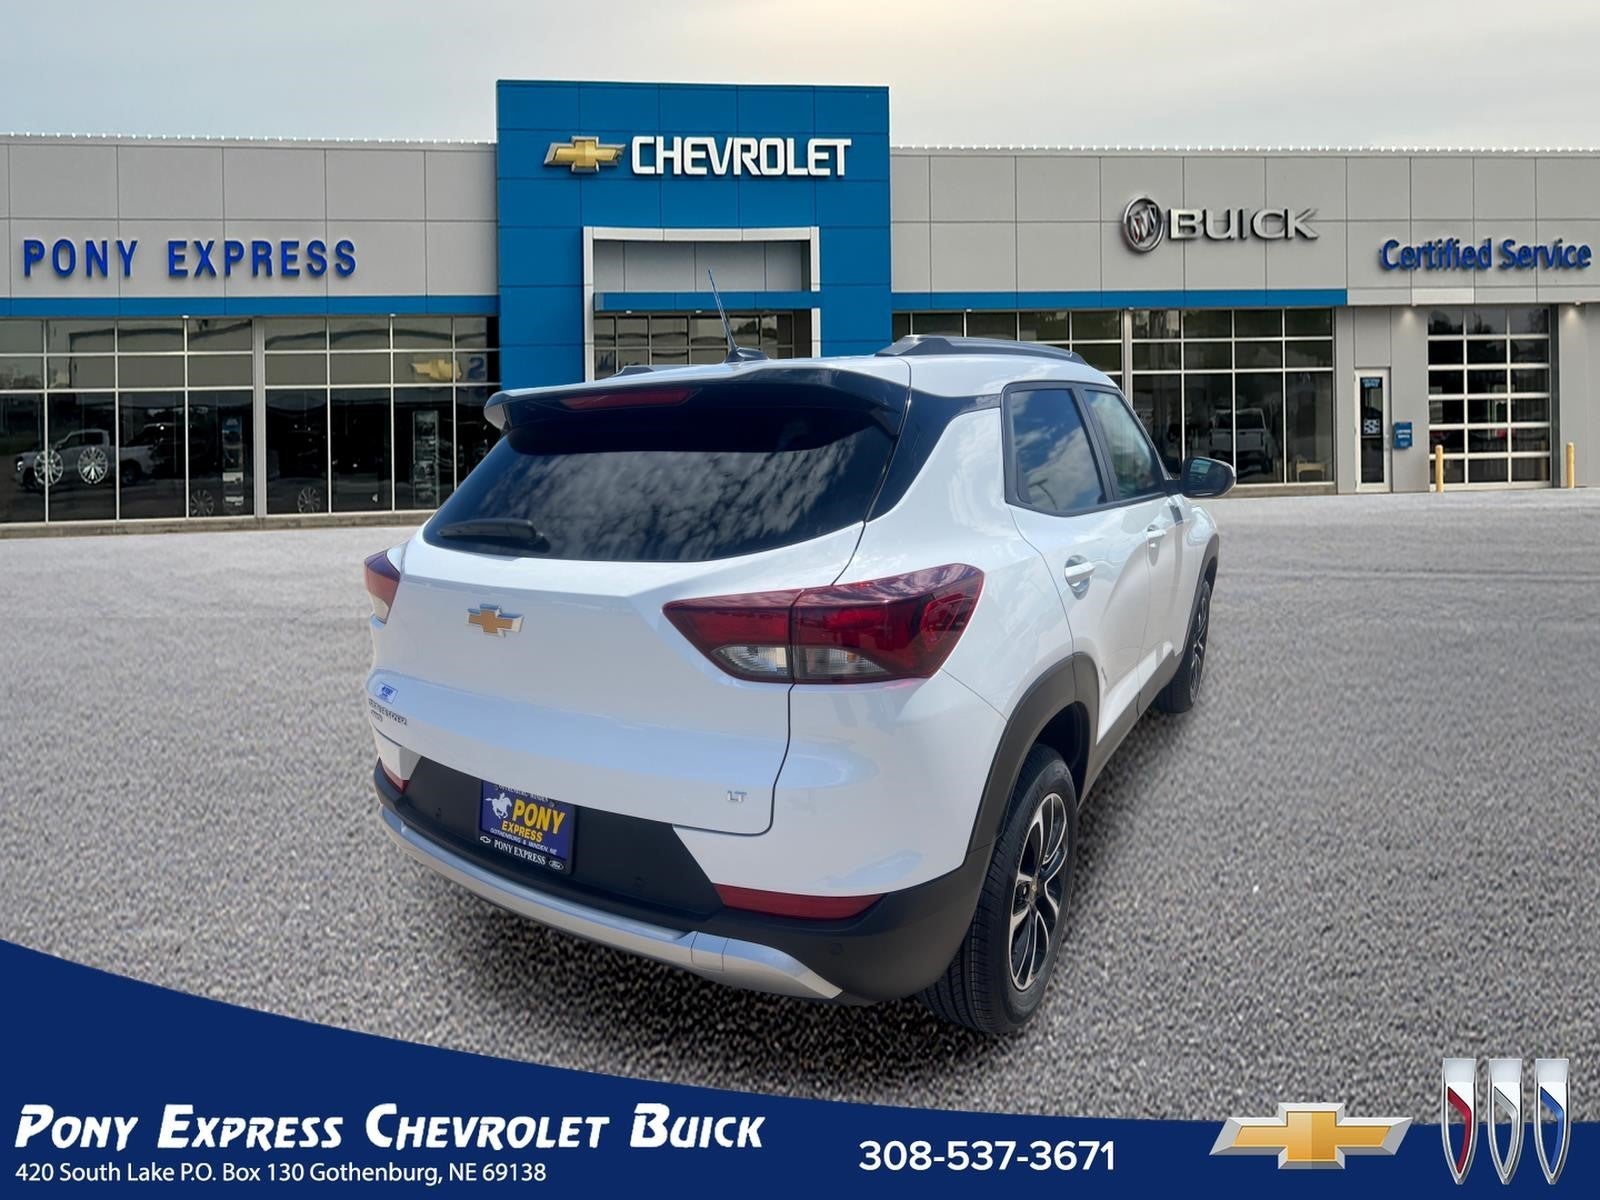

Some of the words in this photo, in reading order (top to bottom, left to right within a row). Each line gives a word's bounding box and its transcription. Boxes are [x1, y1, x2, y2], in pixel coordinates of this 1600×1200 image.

[632, 136, 852, 176] CHEVROLET
[1169, 207, 1318, 240] BUICK
[23, 239, 138, 277] PONY
[167, 239, 357, 277] EXPRESS
[1381, 238, 1493, 270] Certified
[1500, 238, 1592, 269] Service
[727, 790, 747, 802] LT
[501, 820, 544, 843] EXPRESS
[512, 798, 566, 835] PONY
[493, 839, 514, 854] PONY
[513, 846, 546, 865] EXPRESS
